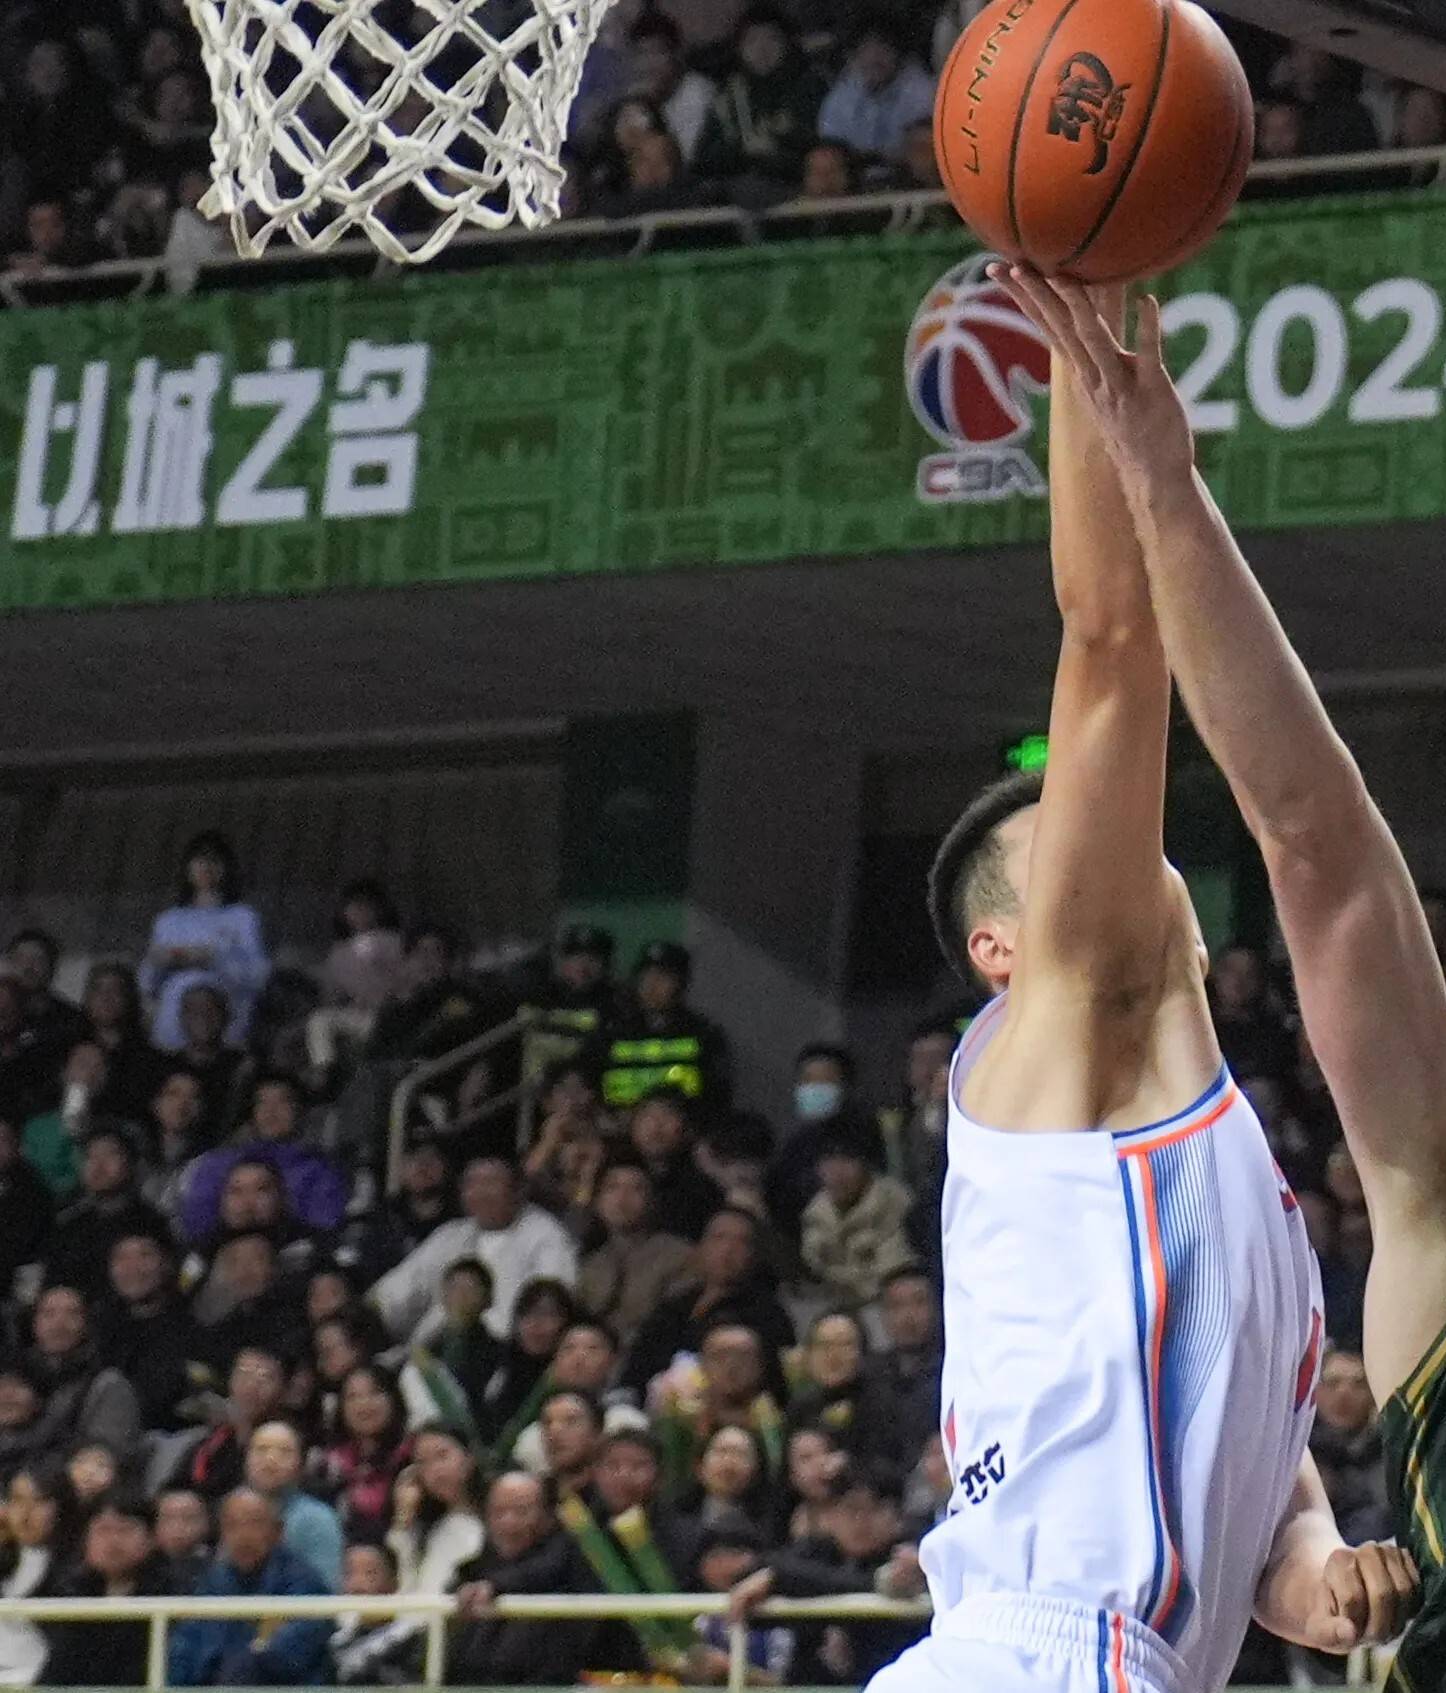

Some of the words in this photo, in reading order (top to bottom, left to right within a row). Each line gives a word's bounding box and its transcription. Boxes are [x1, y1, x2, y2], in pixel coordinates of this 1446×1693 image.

[11, 338, 431, 540] 以城之名
[921, 453, 1048, 499] CBA
